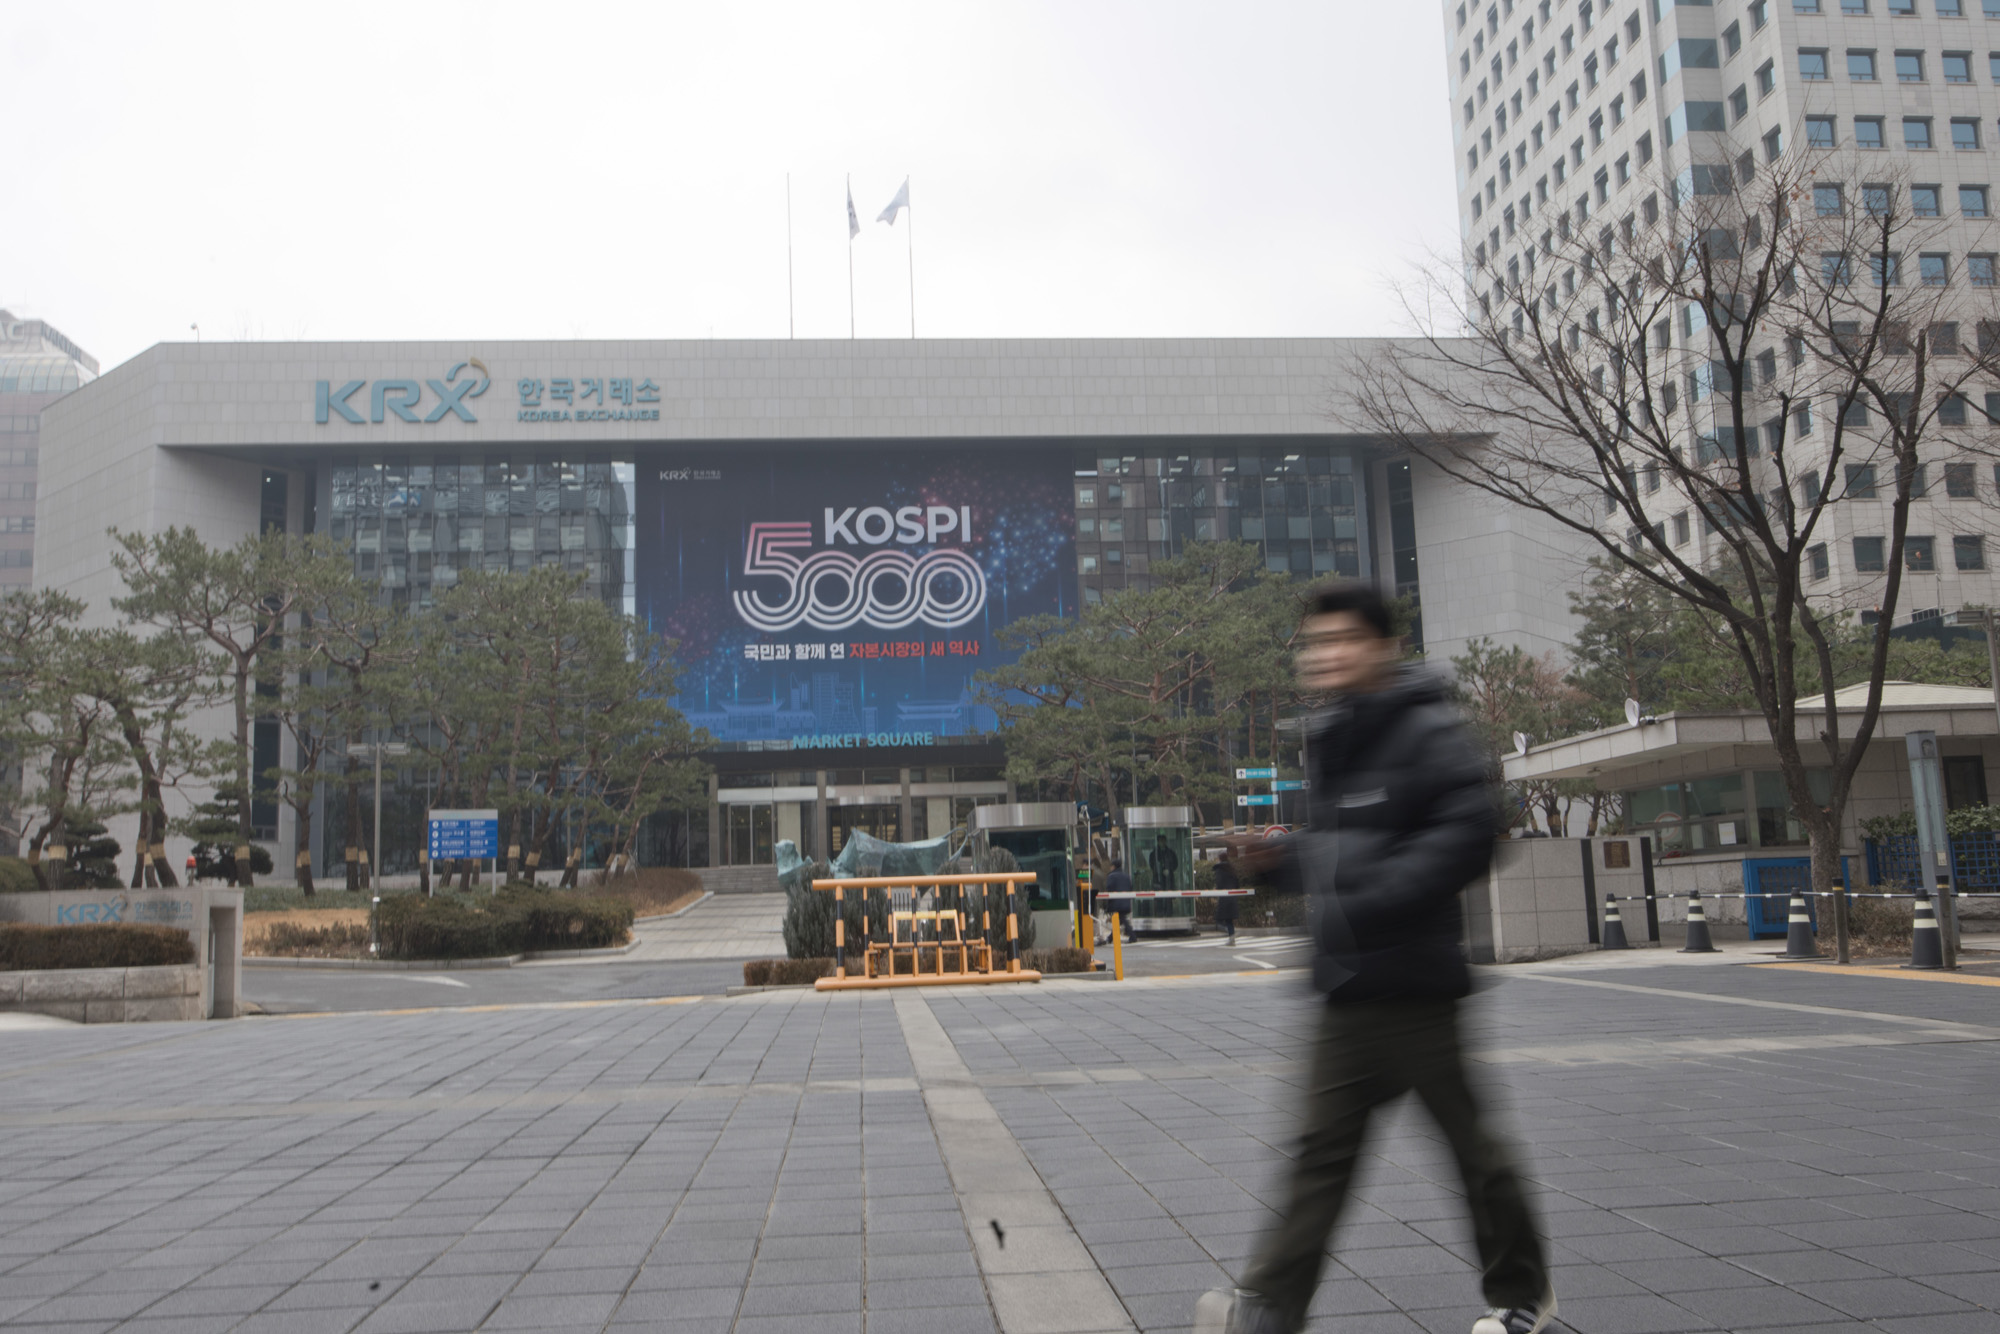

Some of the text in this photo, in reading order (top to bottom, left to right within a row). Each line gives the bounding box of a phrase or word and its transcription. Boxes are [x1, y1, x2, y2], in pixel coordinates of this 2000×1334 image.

[315, 379, 480, 424] KRX
[517, 377, 661, 407] 한국거래소
[517, 408, 661, 423] KOREA EXCHANGE
[659, 470, 689, 481] KRX
[824, 505, 971, 545] KOSPI
[733, 522, 987, 632] 5000
[743, 640, 980, 661] 국민과 함께 연 자본시장의 새 역사
[792, 731, 934, 750] MARKET SQUARE
[57, 902, 122, 924] KRX
